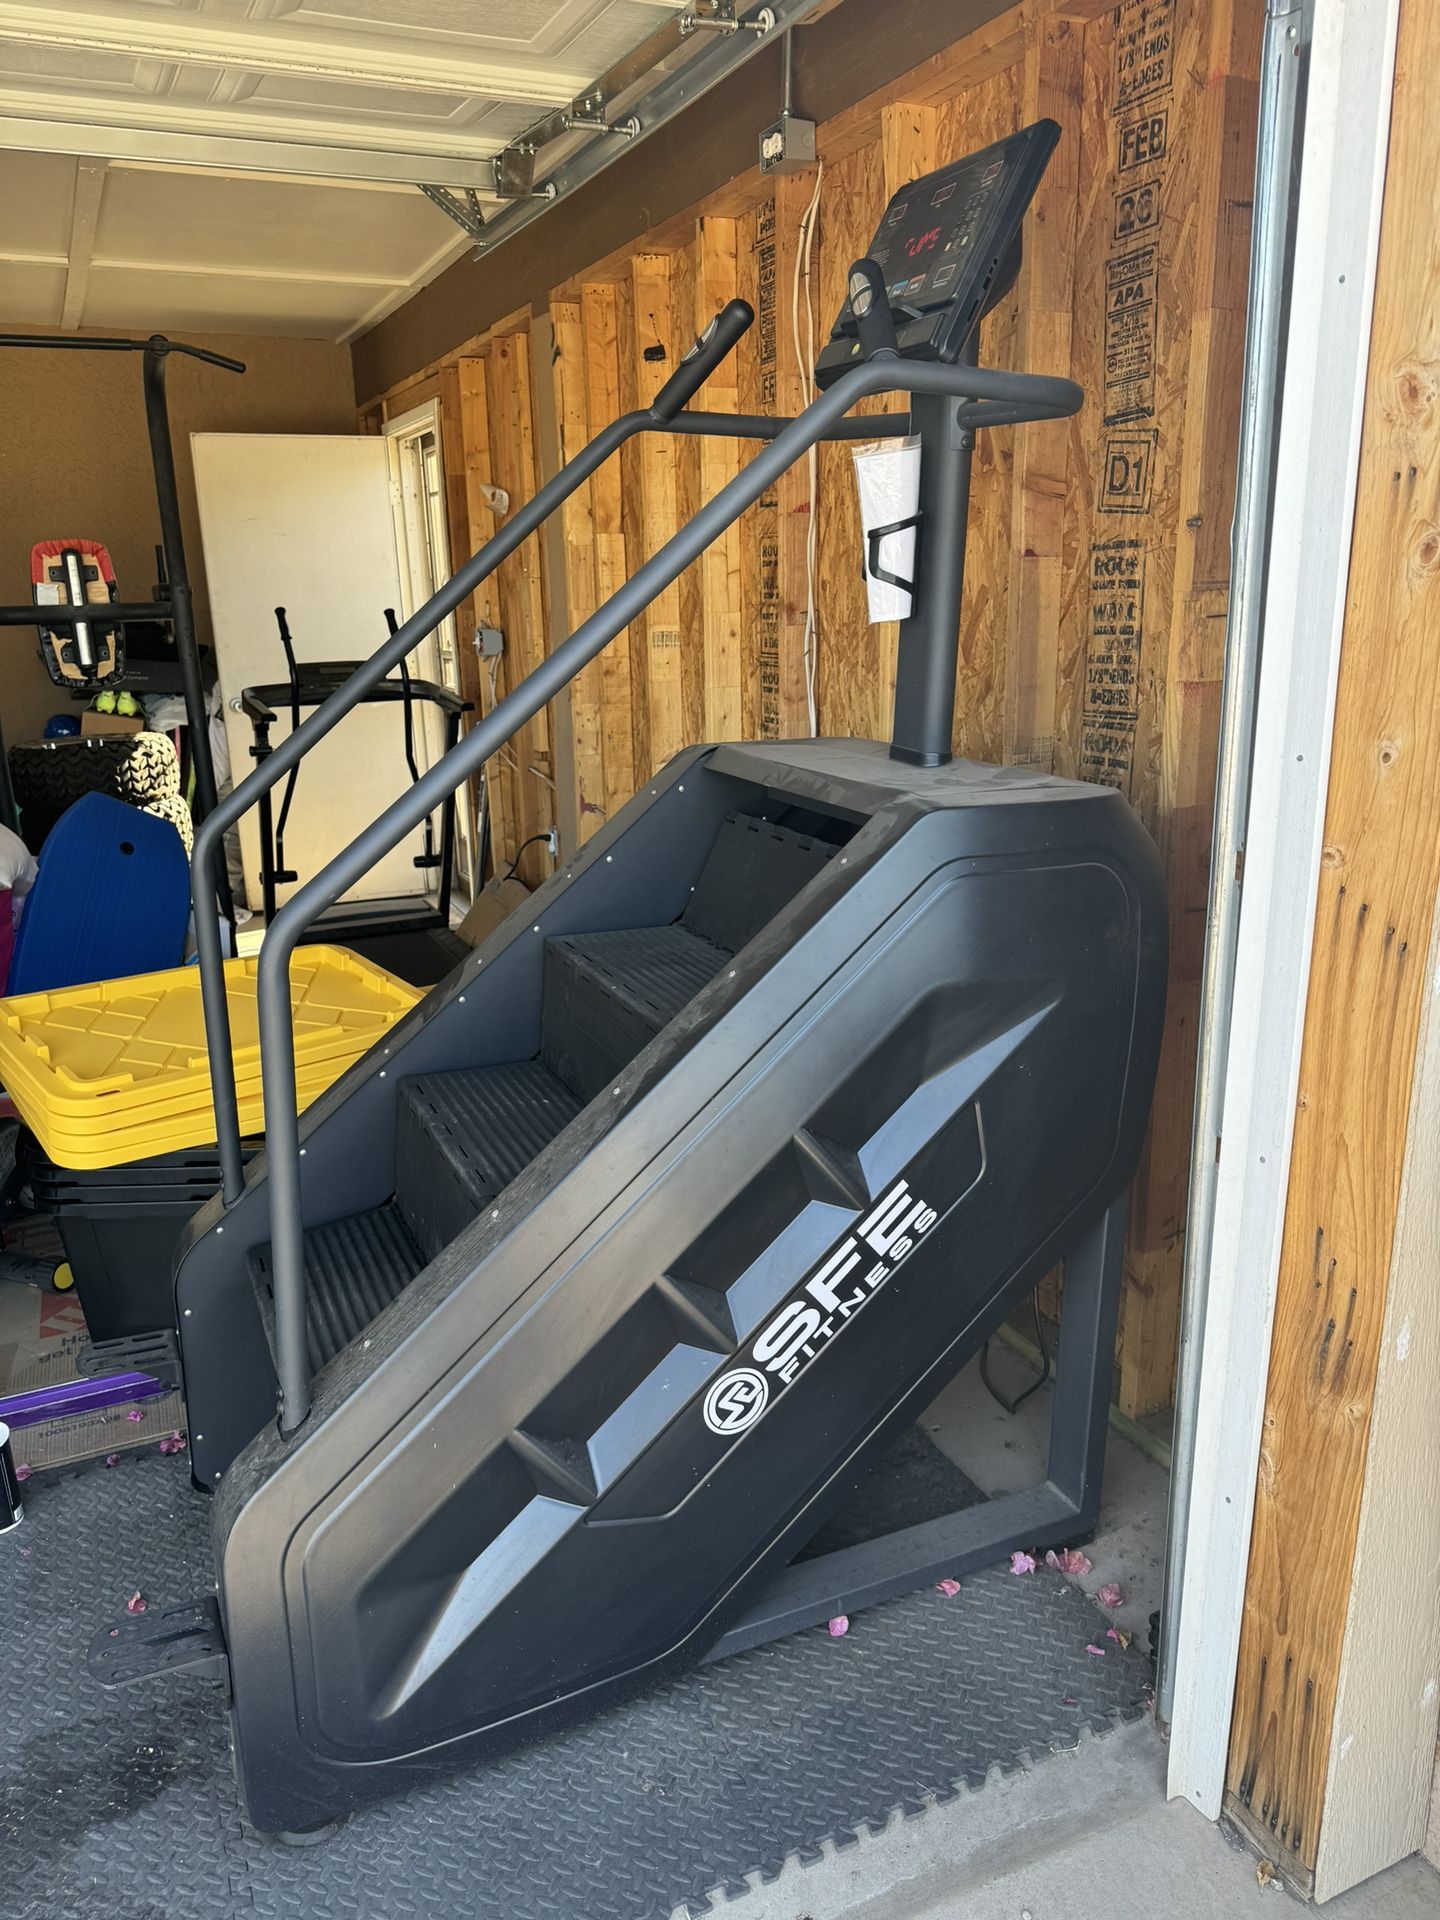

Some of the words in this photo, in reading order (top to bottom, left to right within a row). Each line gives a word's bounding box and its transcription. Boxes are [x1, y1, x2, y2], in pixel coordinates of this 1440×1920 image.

[1121, 117, 1164, 167] FEB
[1113, 282, 1145, 308] APA
[1107, 455, 1144, 495] D1
[752, 1179, 928, 1372] SFE
[777, 1208, 938, 1385] FITNESS
[62, 1333, 90, 1347] Ho
